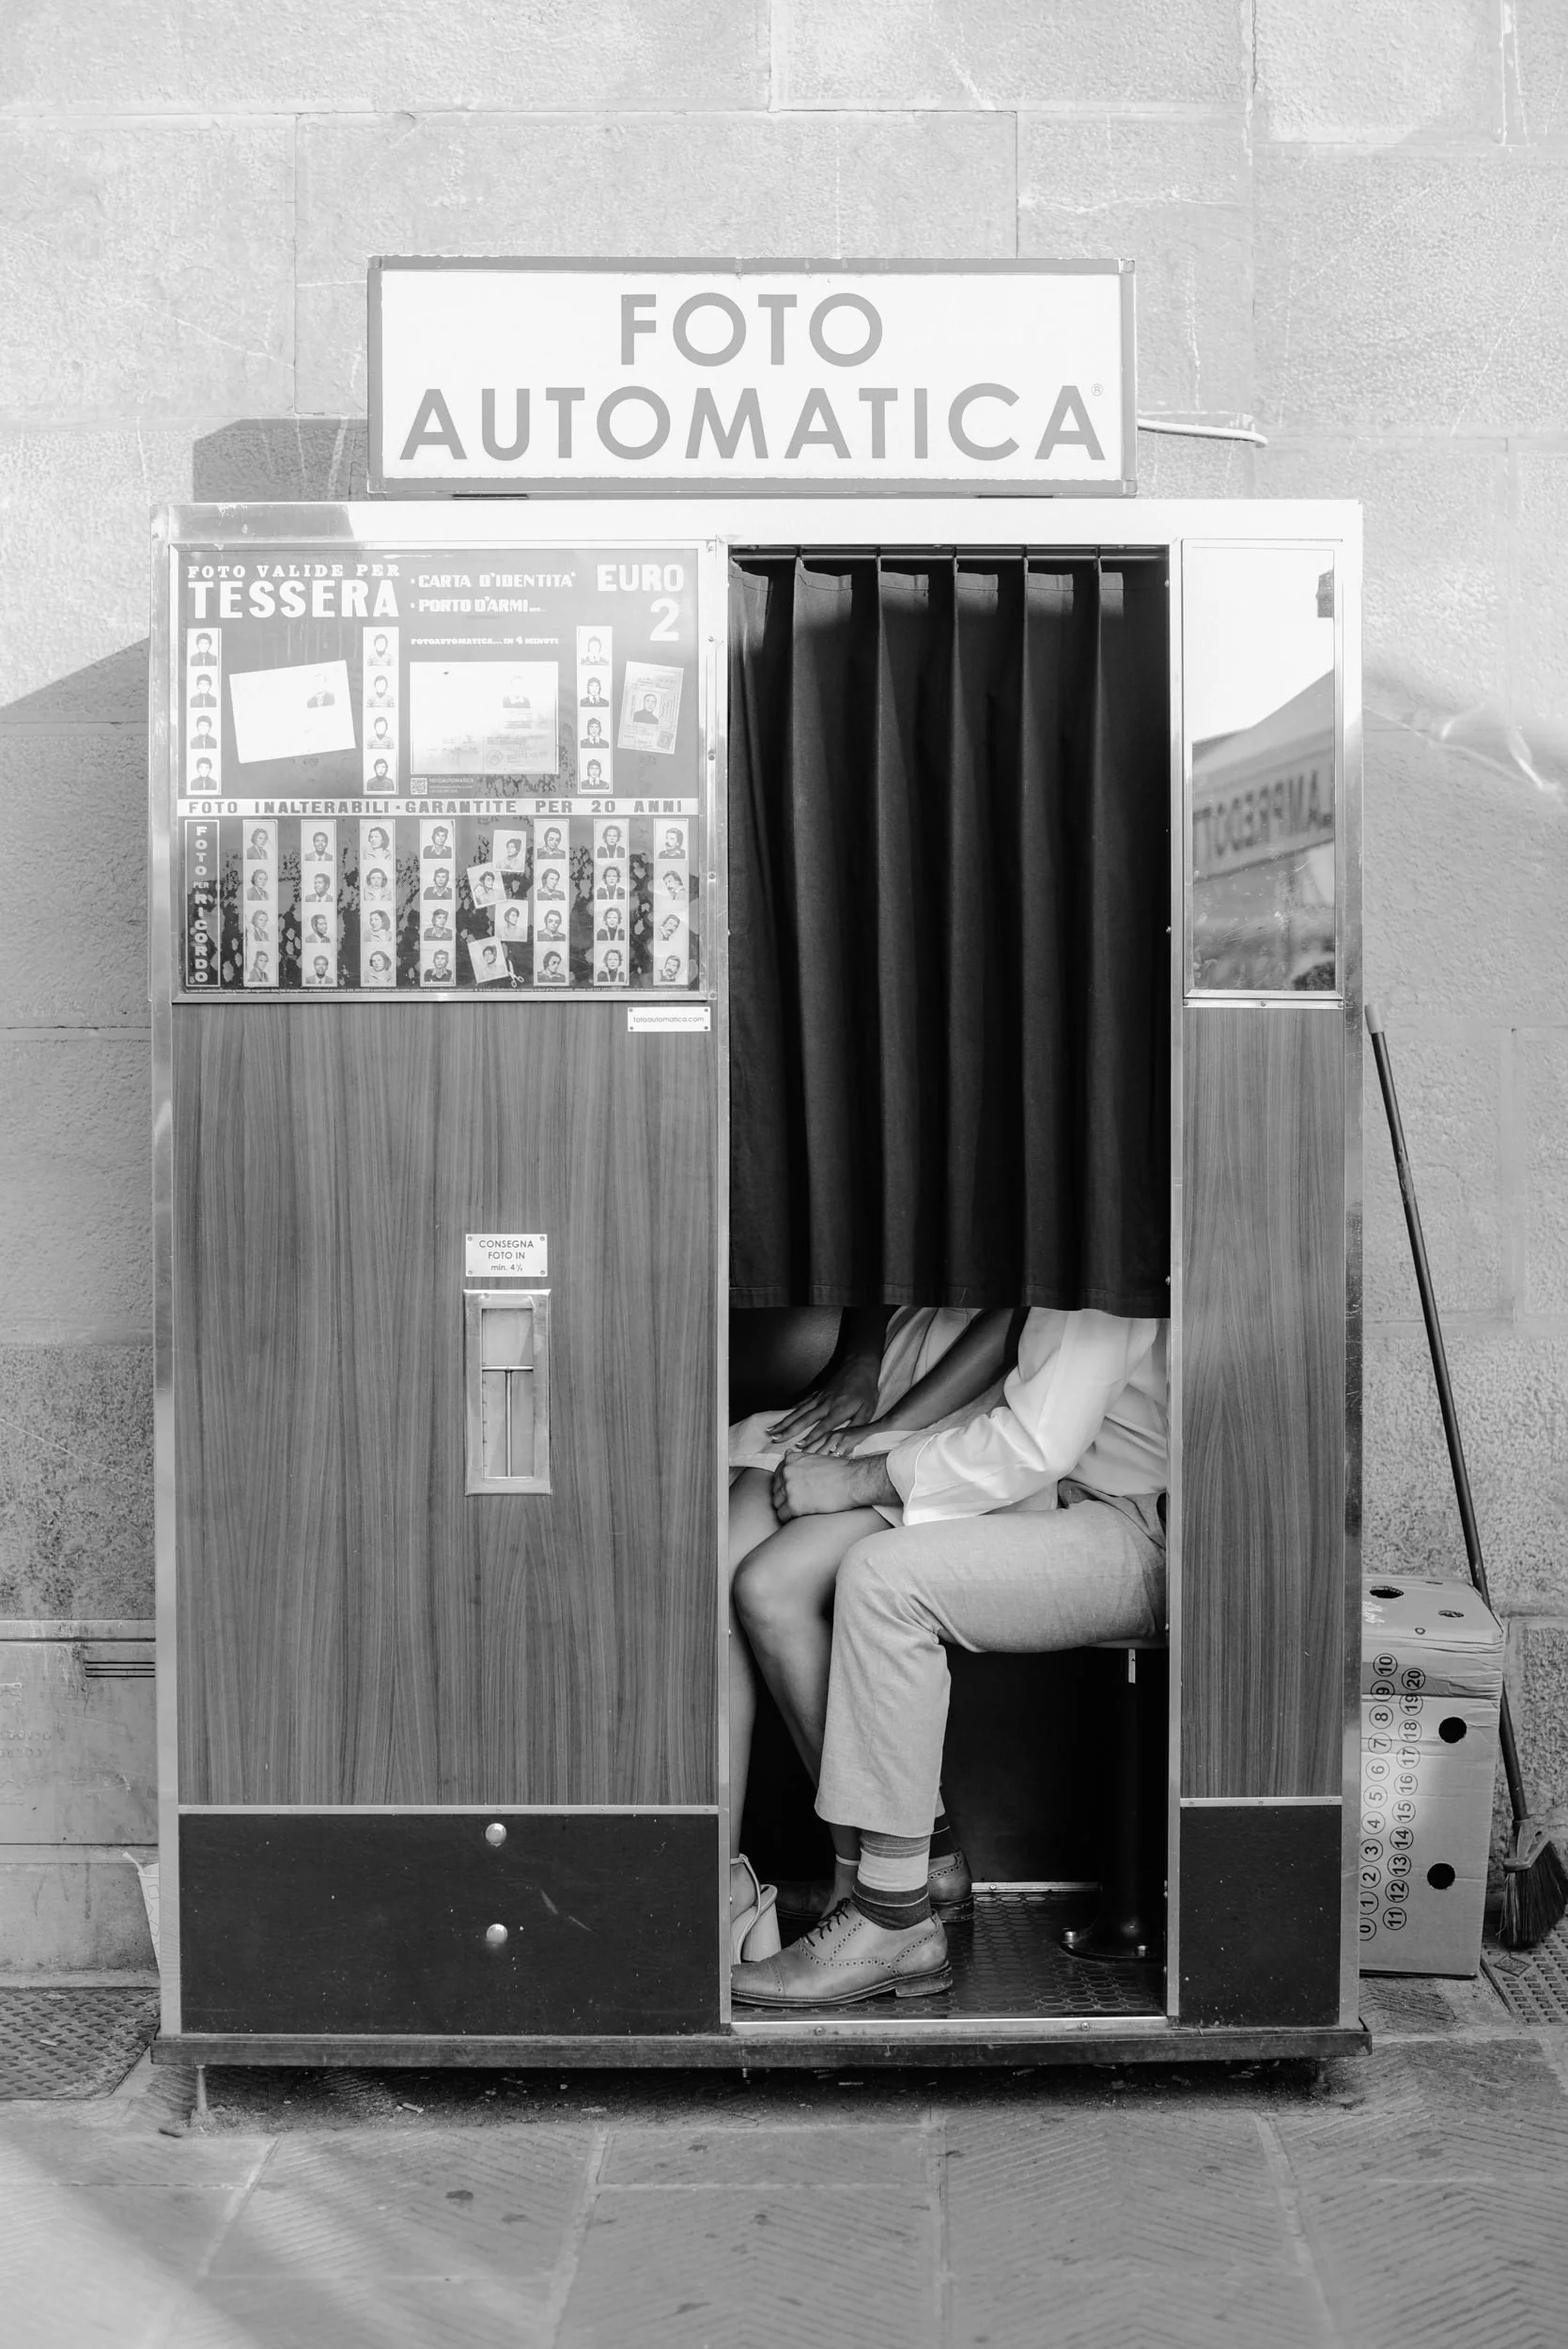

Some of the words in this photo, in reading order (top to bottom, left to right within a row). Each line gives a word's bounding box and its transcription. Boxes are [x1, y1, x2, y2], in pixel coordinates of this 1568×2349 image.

[621, 292, 882, 366] FOTO
[399, 383, 1105, 460] AUTOMATICA
[188, 566, 245, 578] FOTO
[256, 565, 343, 577] VALIDE
[357, 564, 400, 576] PER
[598, 564, 684, 591] EURO
[419, 574, 472, 587] CARTA
[188, 580, 399, 618] TESSERA
[419, 599, 471, 613] PORTO
[650, 599, 679, 641] 2
[189, 801, 239, 814] FOTO
[256, 801, 389, 814] INALTERABILI
[405, 801, 517, 814] GARANTITE
[536, 801, 573, 814] PER
[591, 801, 616, 814] 20
[633, 801, 682, 813] ANNI
[194, 826, 208, 876] FOTO
[194, 894, 209, 983] RICORDO
[1378, 1657, 1392, 1673] 10
[1406, 1671, 1421, 1688] 20
[1404, 1722, 1417, 1739] 18
[1402, 1748, 1416, 1765] 17
[1399, 1775, 1413, 1793] 16
[1397, 1803, 1411, 1821] 15
[1394, 1829, 1409, 1847] 14
[1392, 1857, 1407, 1875] 13
[1389, 1882, 1405, 1901] 12
[1388, 1911, 1402, 1927] 11
